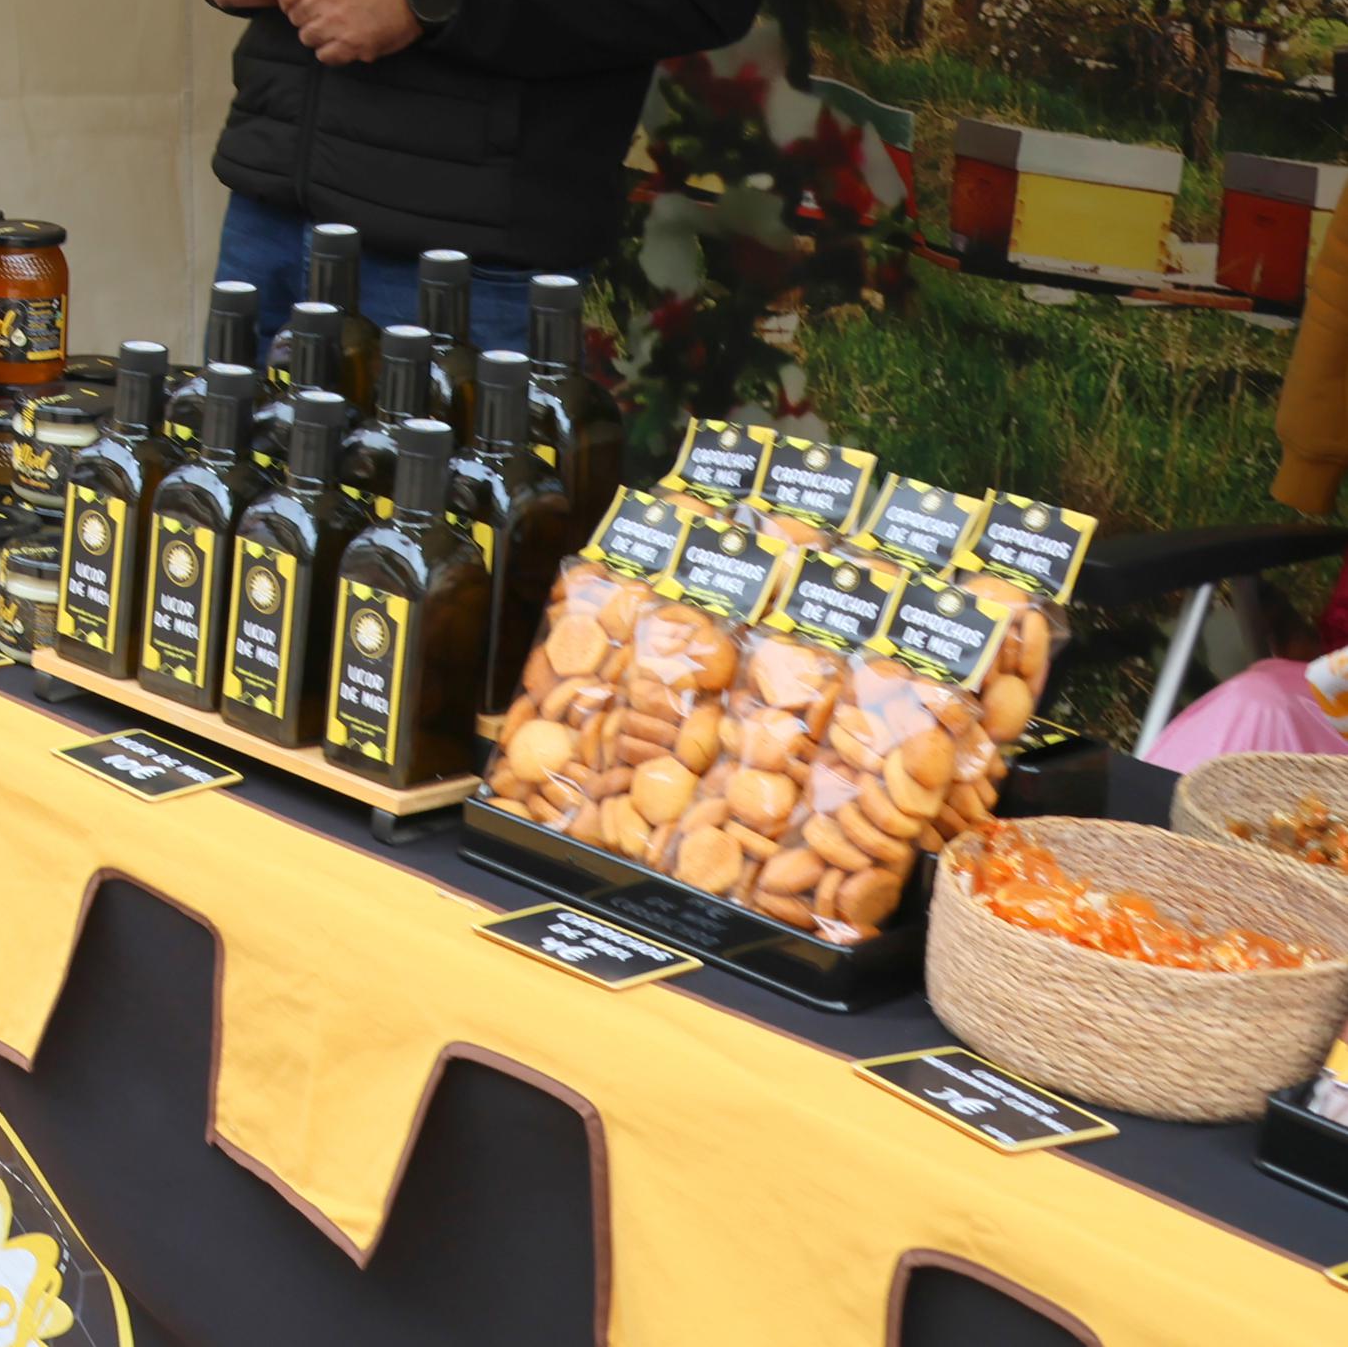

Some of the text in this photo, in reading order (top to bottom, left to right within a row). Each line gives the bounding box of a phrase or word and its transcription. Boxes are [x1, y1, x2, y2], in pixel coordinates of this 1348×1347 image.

[692, 464, 743, 489] DE MIEL
[770, 464, 854, 496] CAPRICHOS
[775, 484, 836, 512] DE MIEL
[884, 524, 940, 555] DE MIEL
[987, 522, 1073, 561] CAPRICHOS
[685, 545, 767, 583] CAPRICHOS
[988, 543, 1053, 578] DE MIEL
[67, 576, 87, 598] DE
[688, 565, 747, 597] DE MIEL
[797, 579, 880, 621] CAPRICHOS
[152, 610, 201, 641] DE MIEL
[799, 600, 861, 636] DE MIEL
[899, 603, 986, 649] CAPRICHOS
[235, 637, 281, 670] DE MIEL
[901, 625, 964, 663] DE MIEL
[339, 681, 392, 717] DE MIEL
[151, 753, 184, 769] DE
[546, 922, 635, 963] DE MIEL
